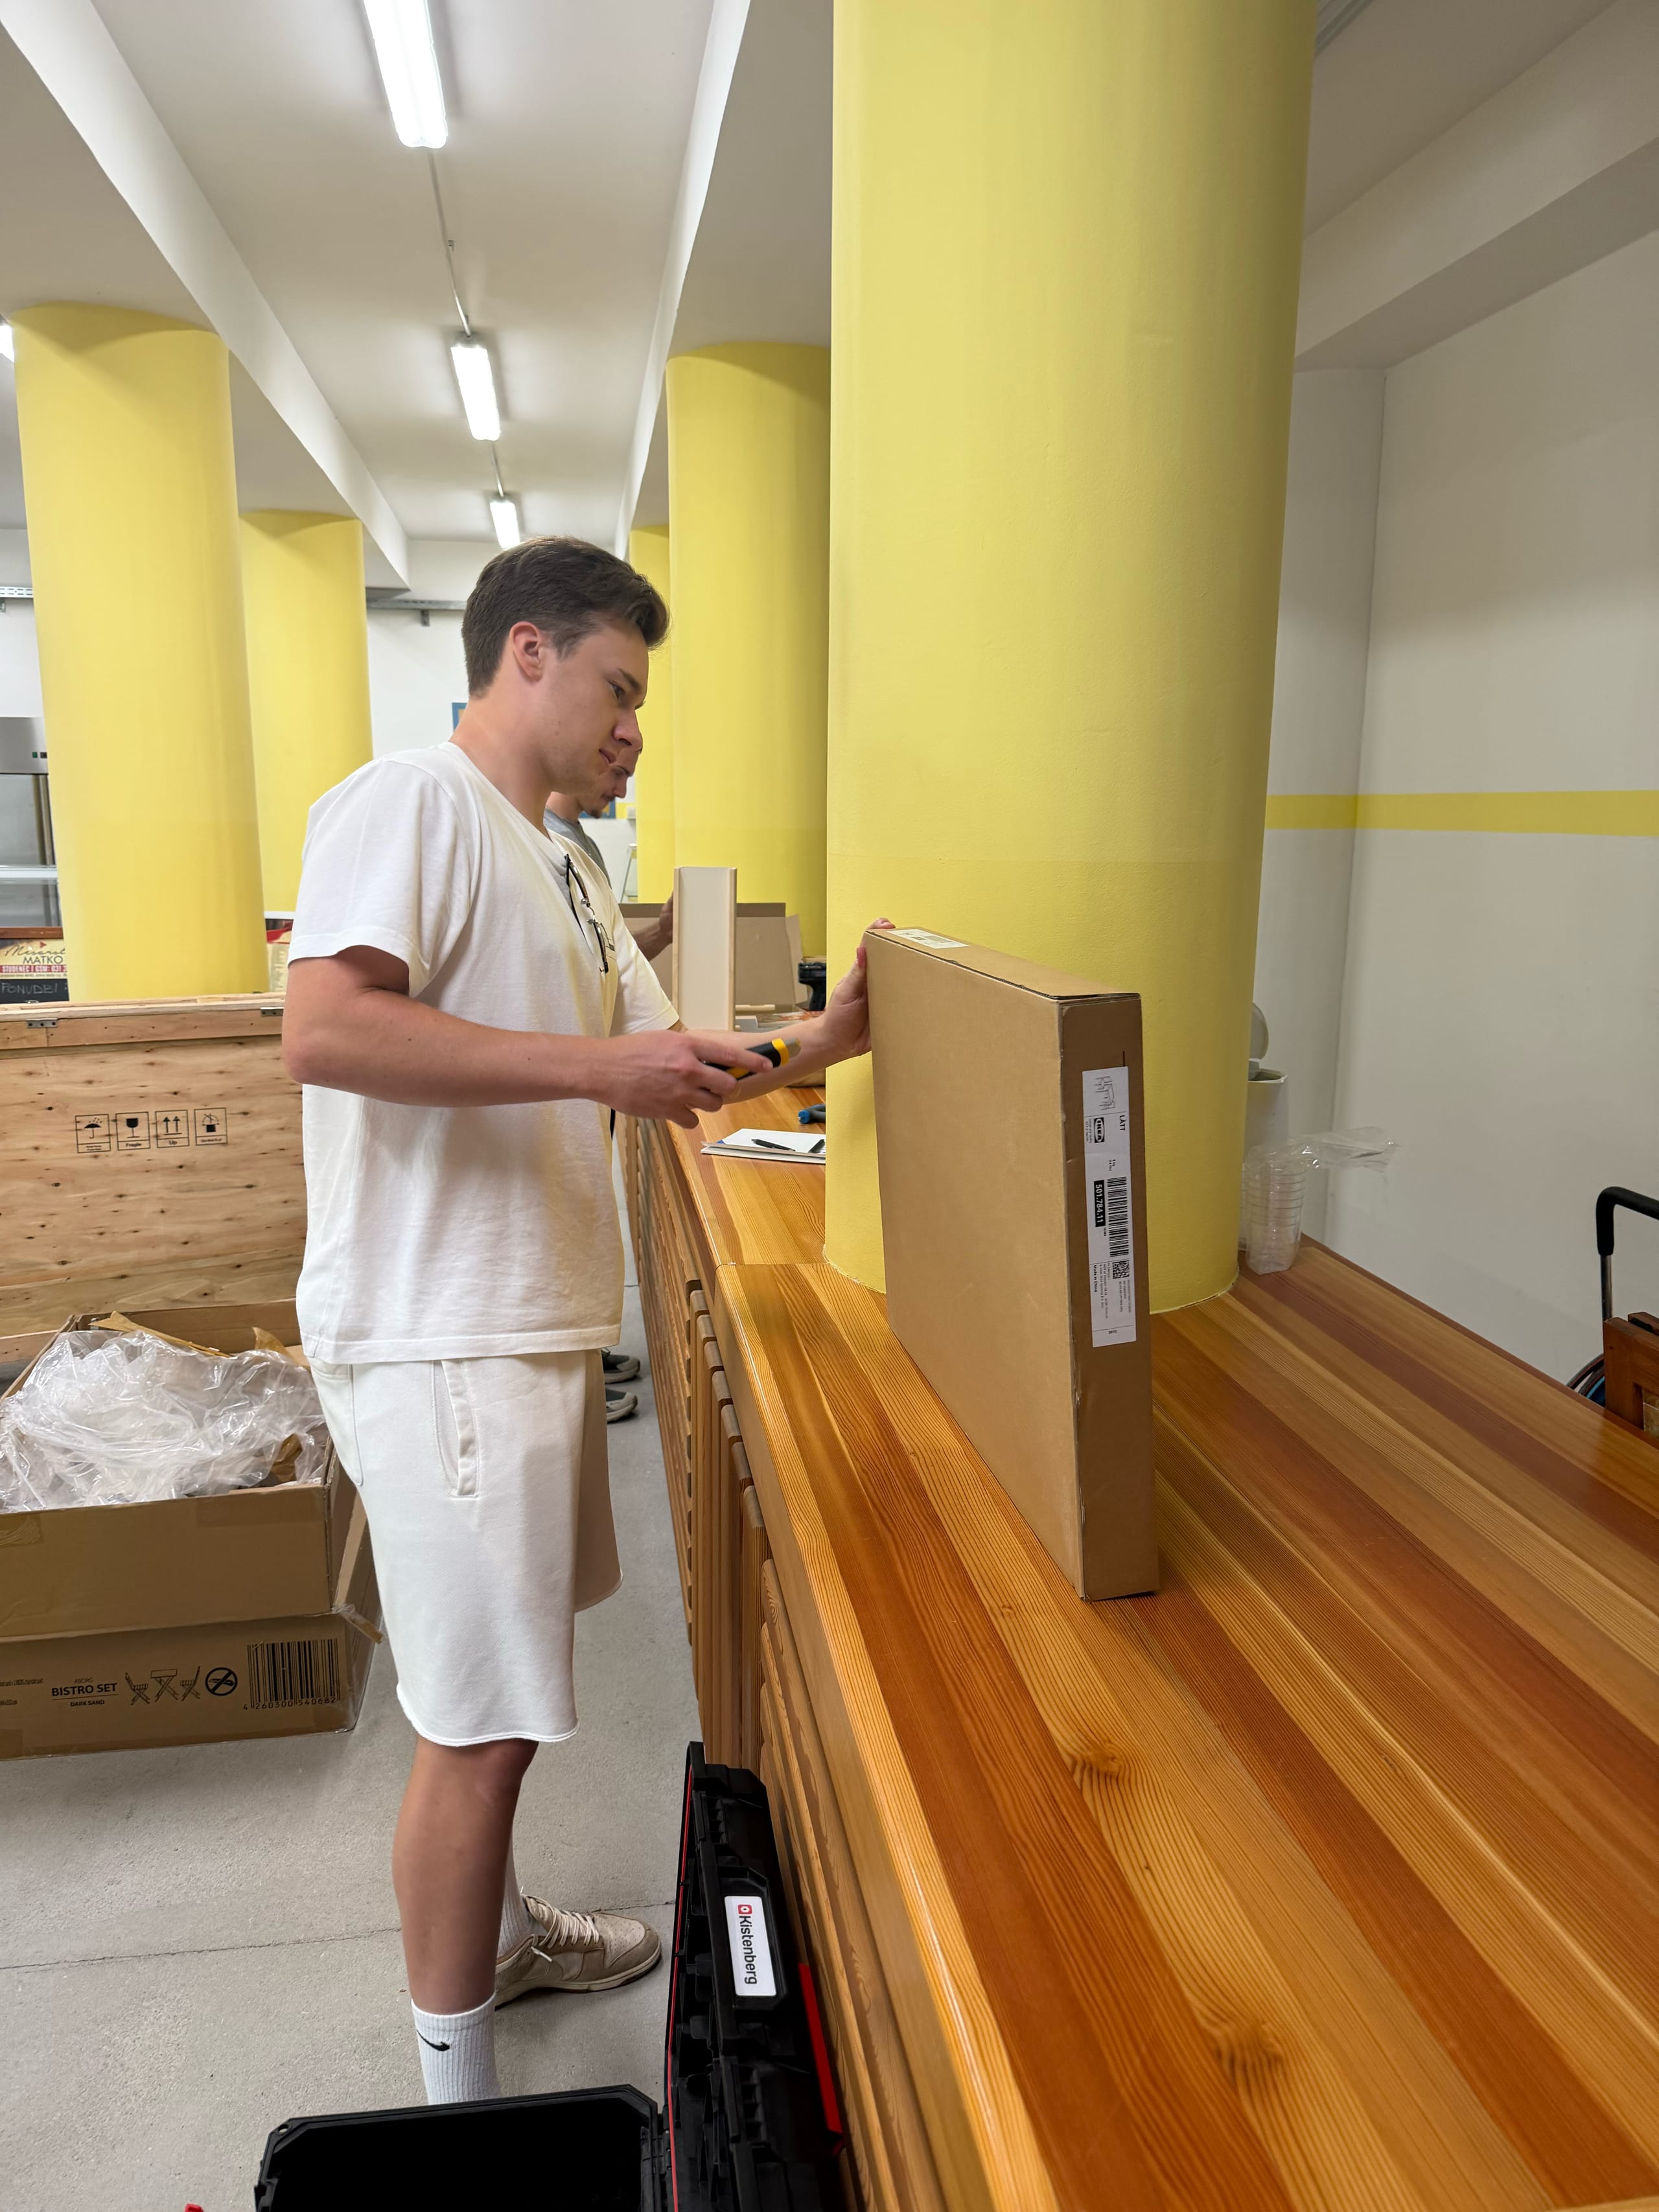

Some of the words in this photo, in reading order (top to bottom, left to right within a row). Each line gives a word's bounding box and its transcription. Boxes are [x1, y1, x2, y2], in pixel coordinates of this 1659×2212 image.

[23, 955, 63, 964] MATKO
[1095, 1184, 1104, 1223] 501.784.11
[52, 1685, 94, 1696] BISTRO
[97, 1683, 117, 1693] SET
[739, 1916, 758, 1985] Kistenberg
